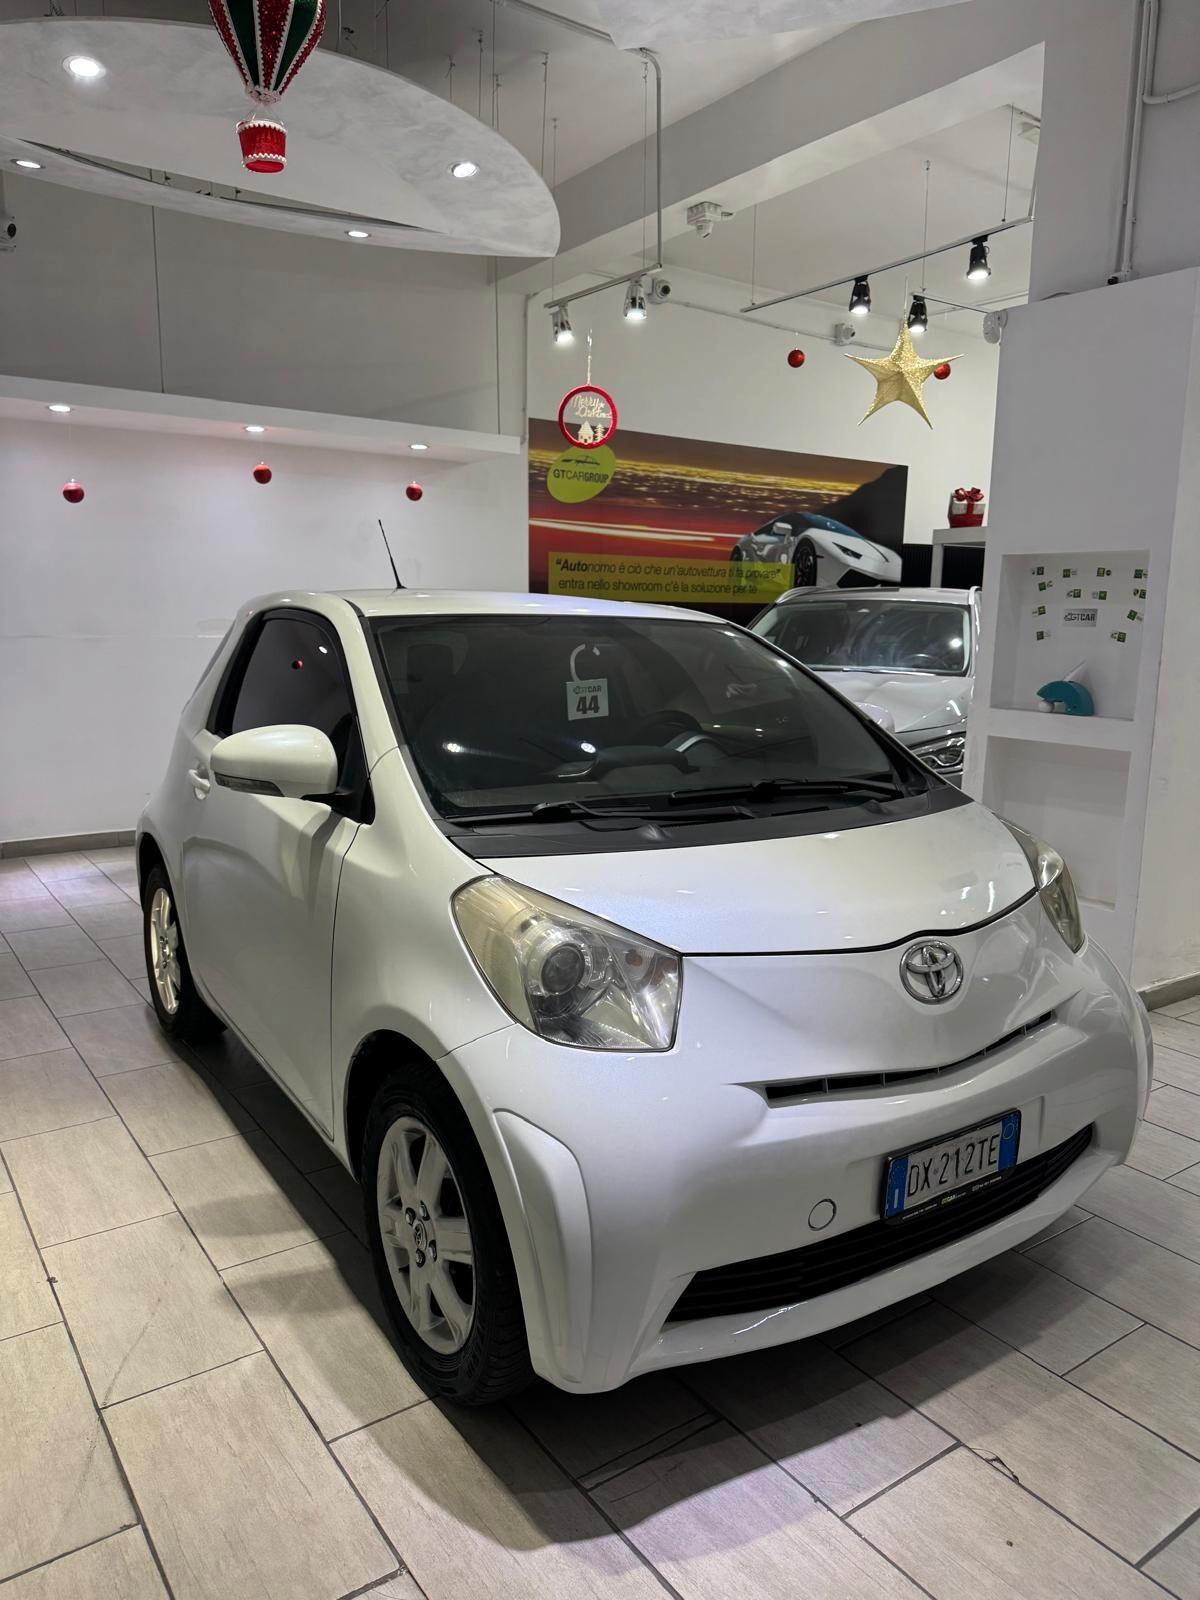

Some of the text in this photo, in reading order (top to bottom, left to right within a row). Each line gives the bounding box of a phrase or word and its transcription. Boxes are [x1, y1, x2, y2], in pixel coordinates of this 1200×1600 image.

[643, 563, 661, 576] che
[558, 579, 585, 590] entra
[588, 578, 610, 591] nello
[612, 580, 663, 593] showroom
[691, 582, 731, 594] soluzione
[733, 584, 748, 596] per
[576, 694, 600, 715] 44
